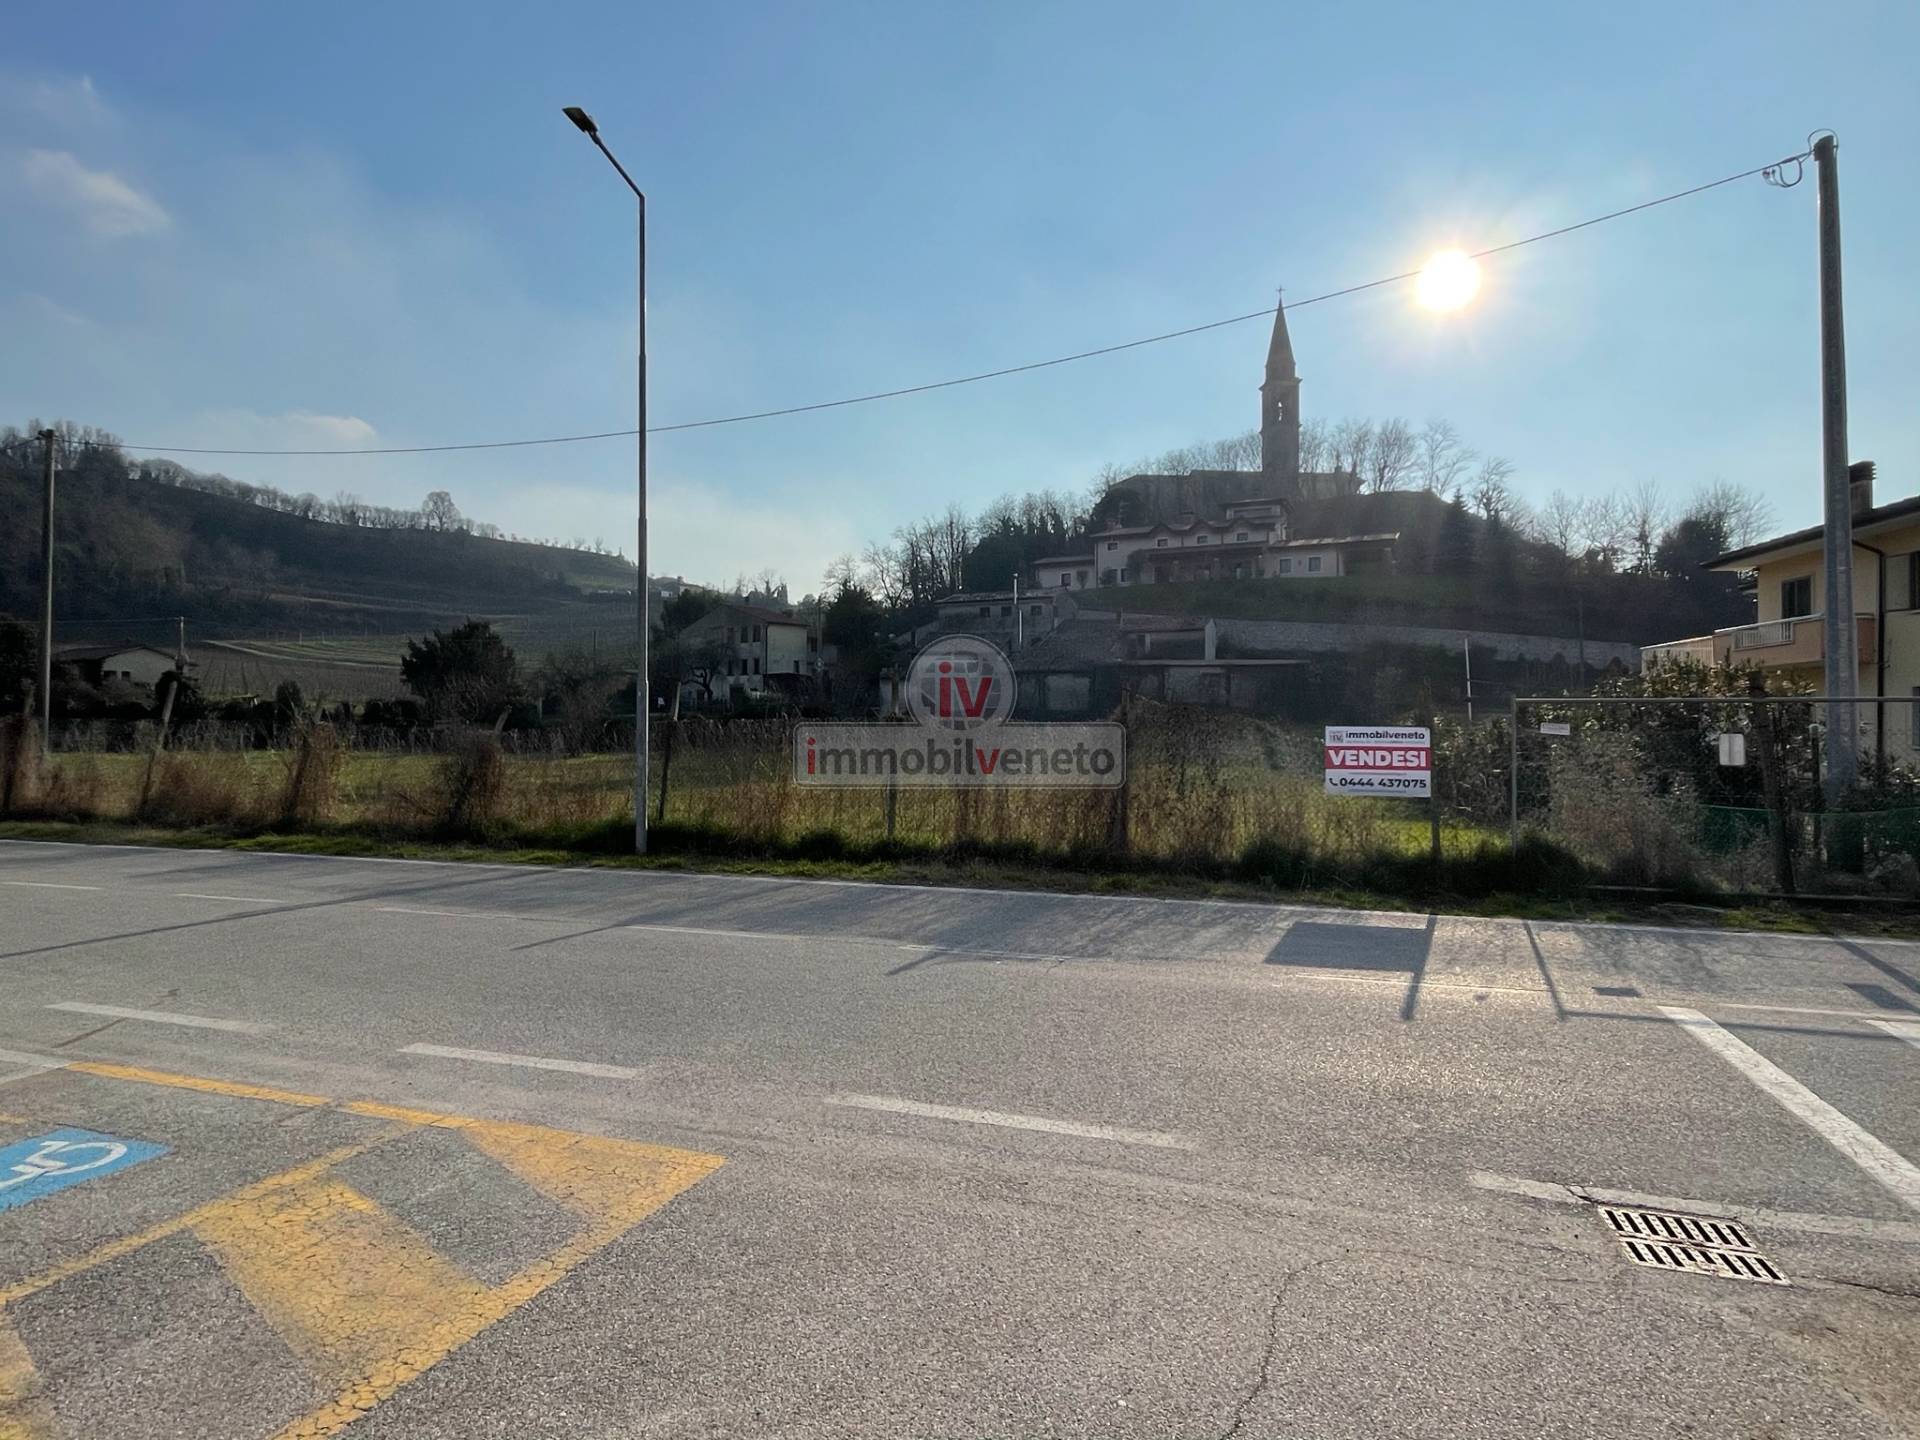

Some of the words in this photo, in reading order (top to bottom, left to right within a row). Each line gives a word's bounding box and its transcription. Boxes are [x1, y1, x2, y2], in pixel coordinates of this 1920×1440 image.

[1345, 731, 1425, 740] immobilveneto
[1328, 749, 1427, 768] VENDESI
[1339, 777, 1375, 787] 0444
[1378, 779, 1427, 789] 437075
